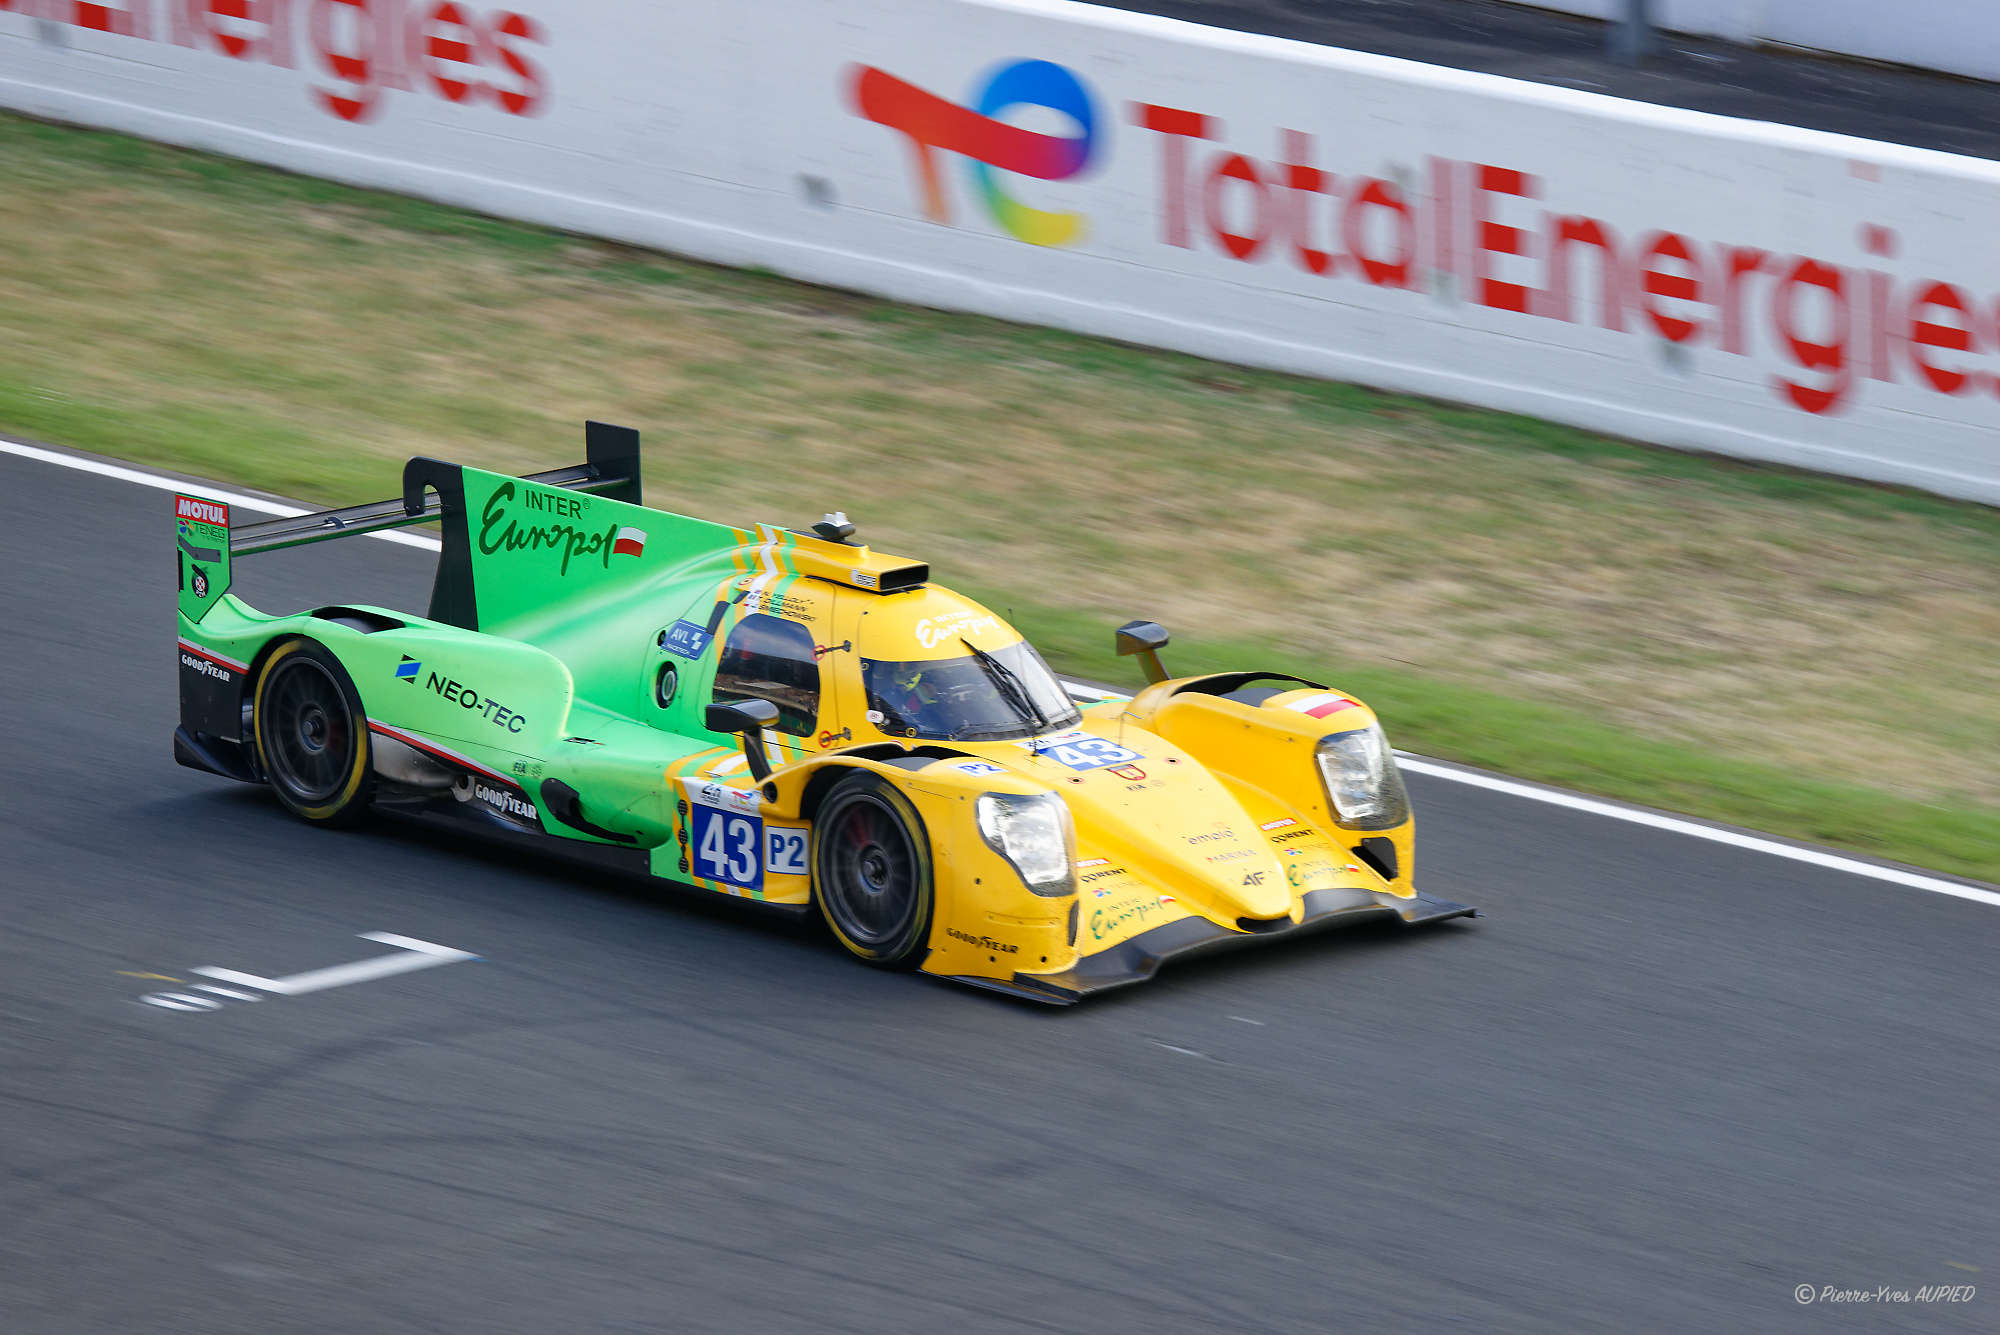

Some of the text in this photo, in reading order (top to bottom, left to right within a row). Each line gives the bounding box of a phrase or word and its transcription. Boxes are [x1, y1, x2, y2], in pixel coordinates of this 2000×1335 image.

[1125, 98, 2000, 417] TotalEnergie
[177, 498, 226, 525] MOTUL
[478, 481, 618, 577] Europol
[670, 627, 689, 645] AVL
[181, 654, 231, 682] GOODYEAR
[426, 671, 526, 734] NEO-TEC
[957, 762, 1001, 777] P2
[1051, 739, 1138, 767] 43
[475, 784, 538, 820] GOODYEAR
[699, 811, 758, 884] 43
[768, 832, 805, 868] P2
